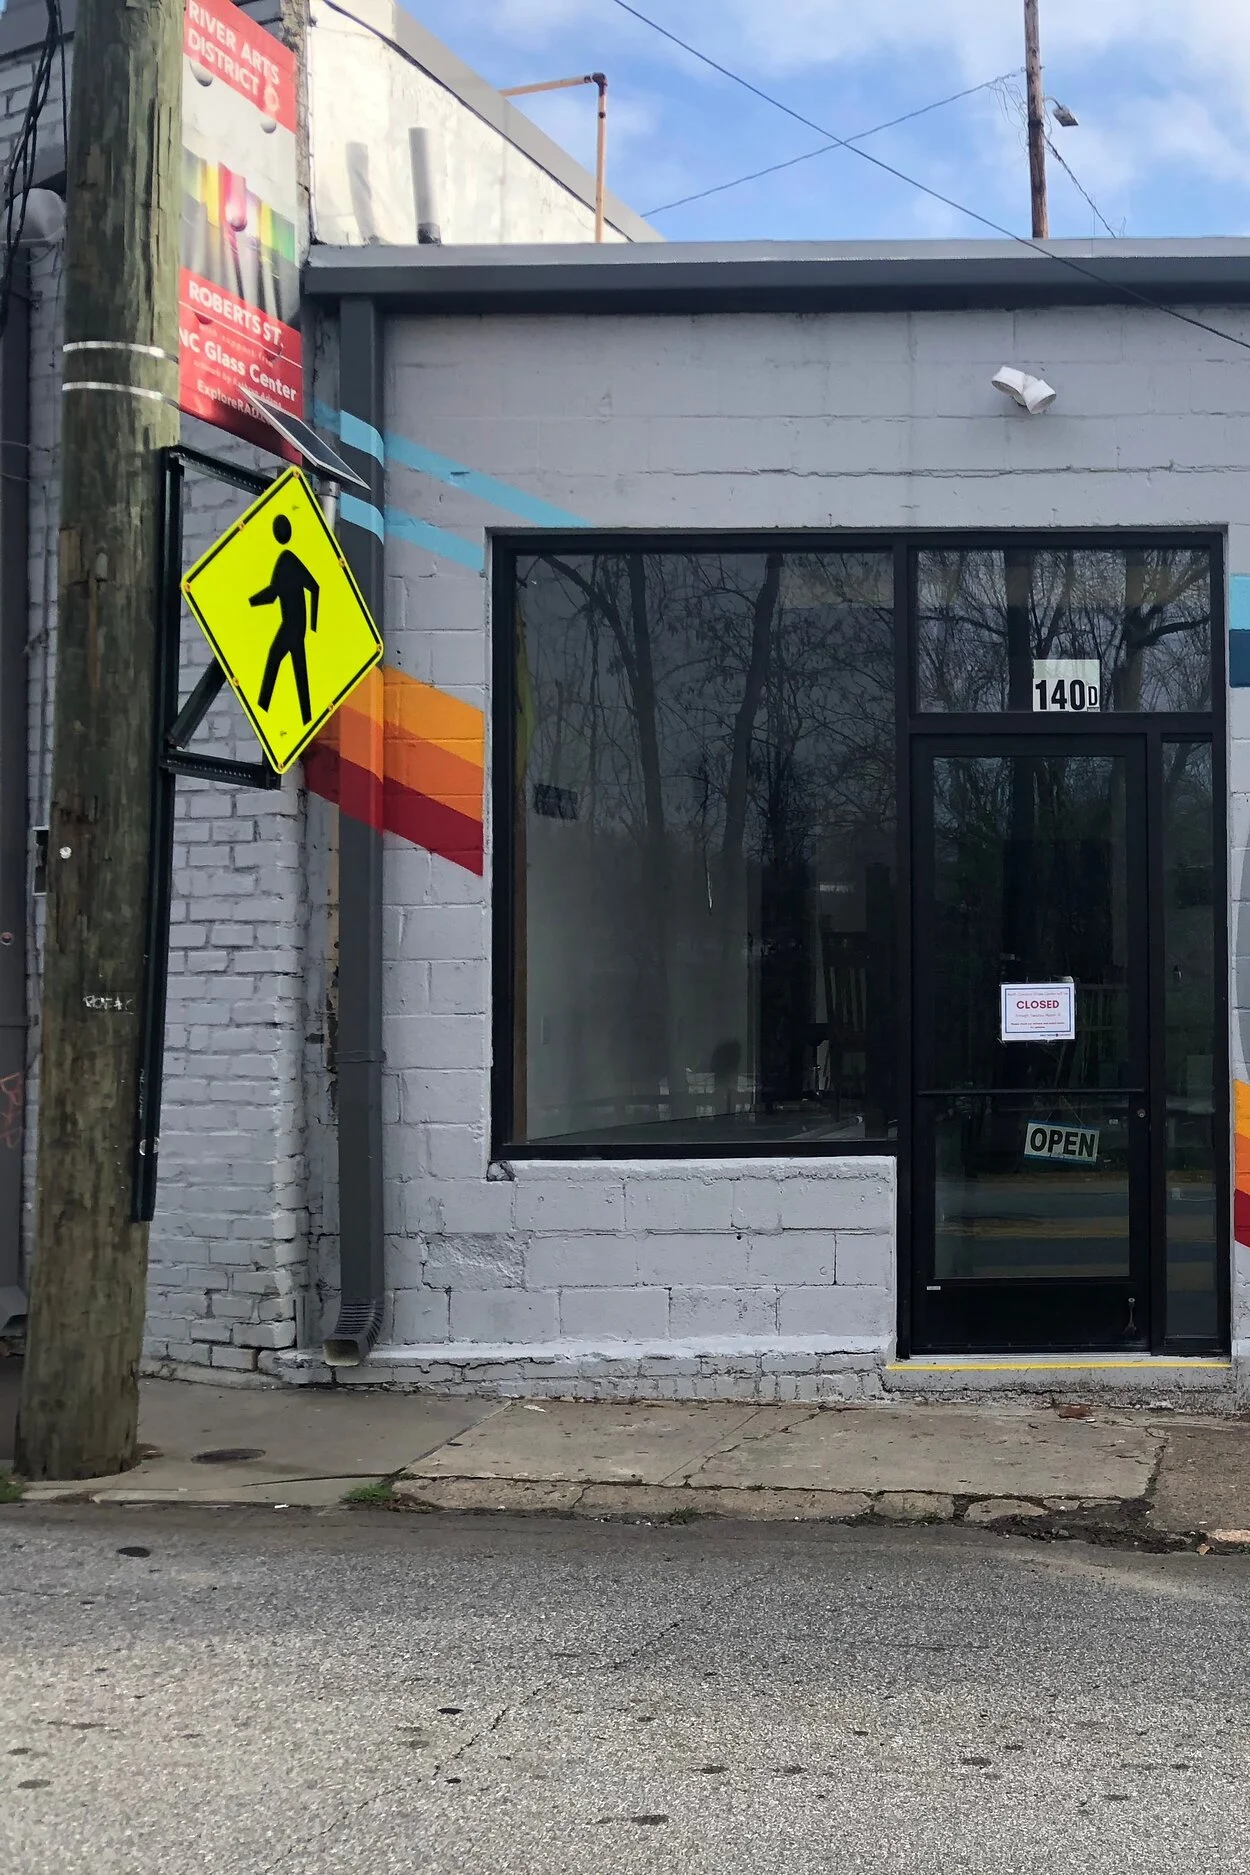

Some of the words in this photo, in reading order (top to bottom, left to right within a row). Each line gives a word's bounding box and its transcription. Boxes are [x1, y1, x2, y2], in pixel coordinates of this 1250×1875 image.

[188, 27, 259, 96] DISTRICT
[189, 0, 236, 53] RIVER
[241, 42, 280, 85] ARTS
[189, 280, 261, 335] ROBERTS
[263, 321, 284, 347] ST.
[179, 326, 200, 353] NC
[204, 340, 246, 376] Glass
[250, 363, 297, 401] Center
[1016, 1000, 1059, 1009] CLOSED
[1030, 1127, 1096, 1158] OPEN
